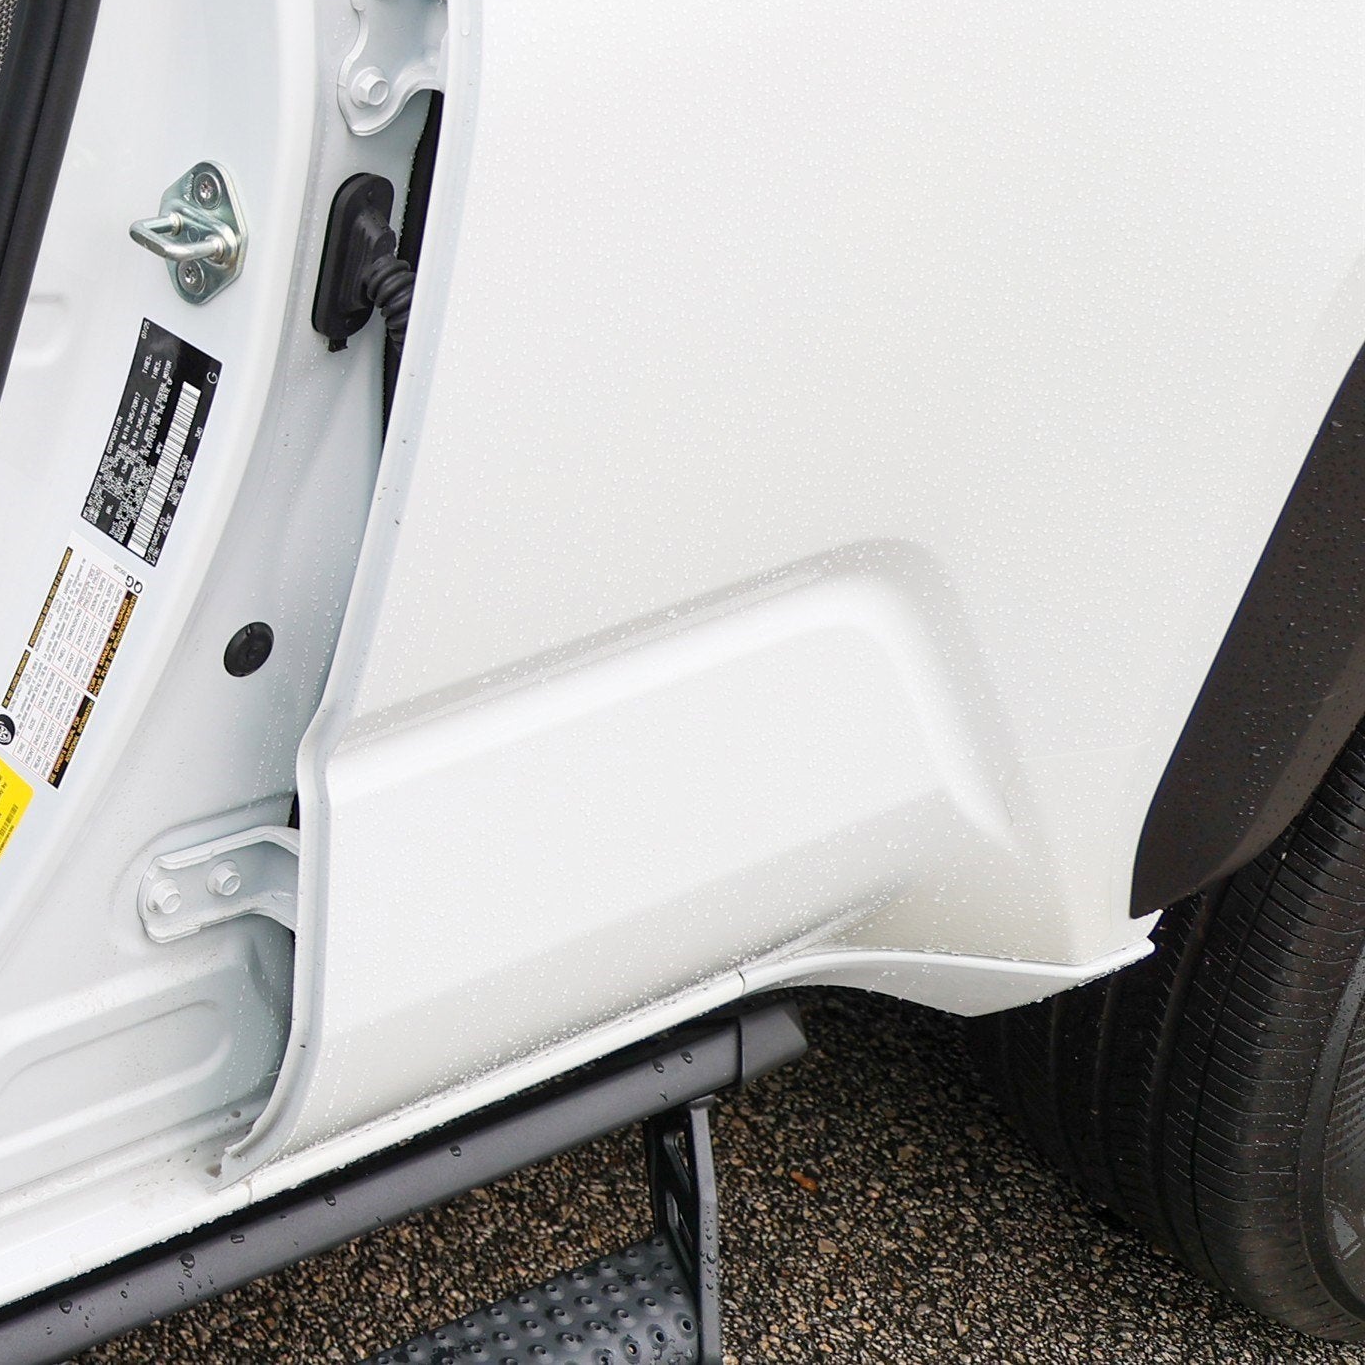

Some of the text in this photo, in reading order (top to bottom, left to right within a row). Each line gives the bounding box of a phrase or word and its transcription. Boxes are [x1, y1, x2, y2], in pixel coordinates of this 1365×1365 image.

[141, 321, 150, 339] 07/25
[206, 371, 221, 387] G
[127, 392, 140, 424] 245/70R17
[136, 398, 150, 430] 245/70R17
[106, 416, 123, 454] CORPORATION
[125, 575, 143, 594] QG
[99, 643, 112, 666] MANUEL
[101, 661, 111, 677] PLUS
